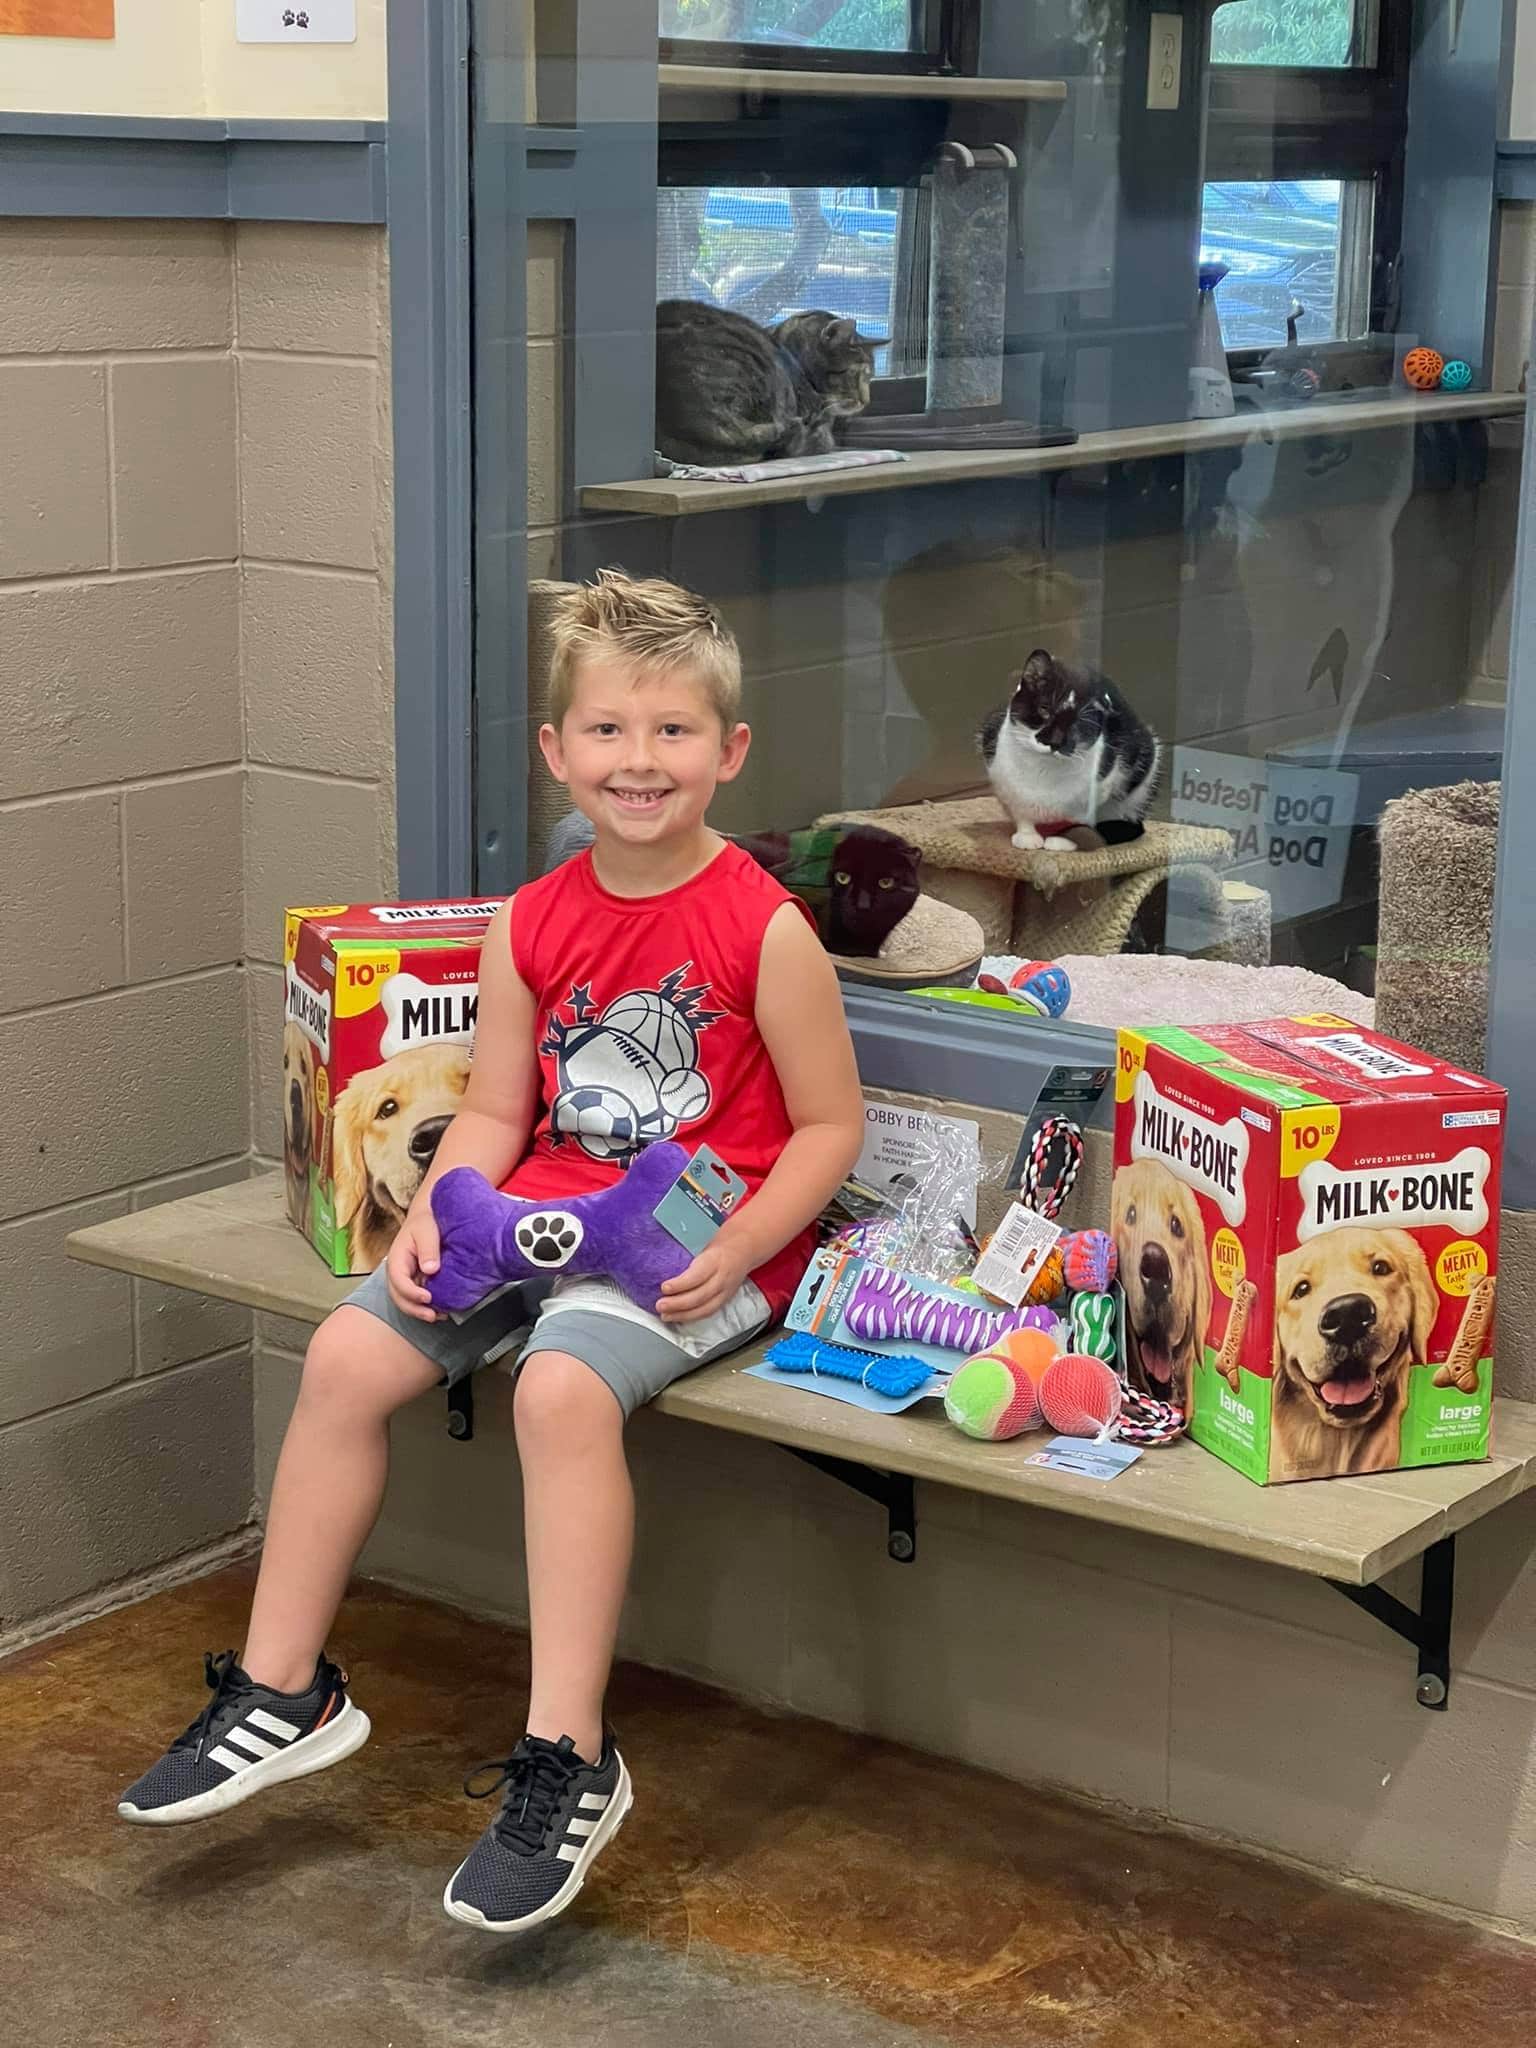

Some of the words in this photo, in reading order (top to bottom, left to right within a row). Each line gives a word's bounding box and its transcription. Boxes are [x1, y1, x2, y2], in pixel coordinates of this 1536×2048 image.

[346, 964, 375, 986] 10
[376, 963, 390, 974] LBS
[443, 972, 476, 980] LOVED
[402, 995, 479, 1040] MILK
[1119, 1047, 1133, 1073] 10
[866, 1108, 904, 1127] OBBY
[1141, 1100, 1184, 1162] MILK
[1190, 1126, 1239, 1197] BONE
[1292, 1126, 1320, 1150] 10
[1321, 1124, 1335, 1136] LBS
[1354, 1157, 1384, 1166] LOVED
[1386, 1154, 1413, 1163] SINCE
[1316, 1179, 1391, 1225] MILK
[1402, 1171, 1475, 1212] BONE
[1216, 1242, 1239, 1267] MEATY
[1443, 1250, 1480, 1274] MEATY
[1220, 1387, 1255, 1426] large
[1440, 1405, 1482, 1420] large
